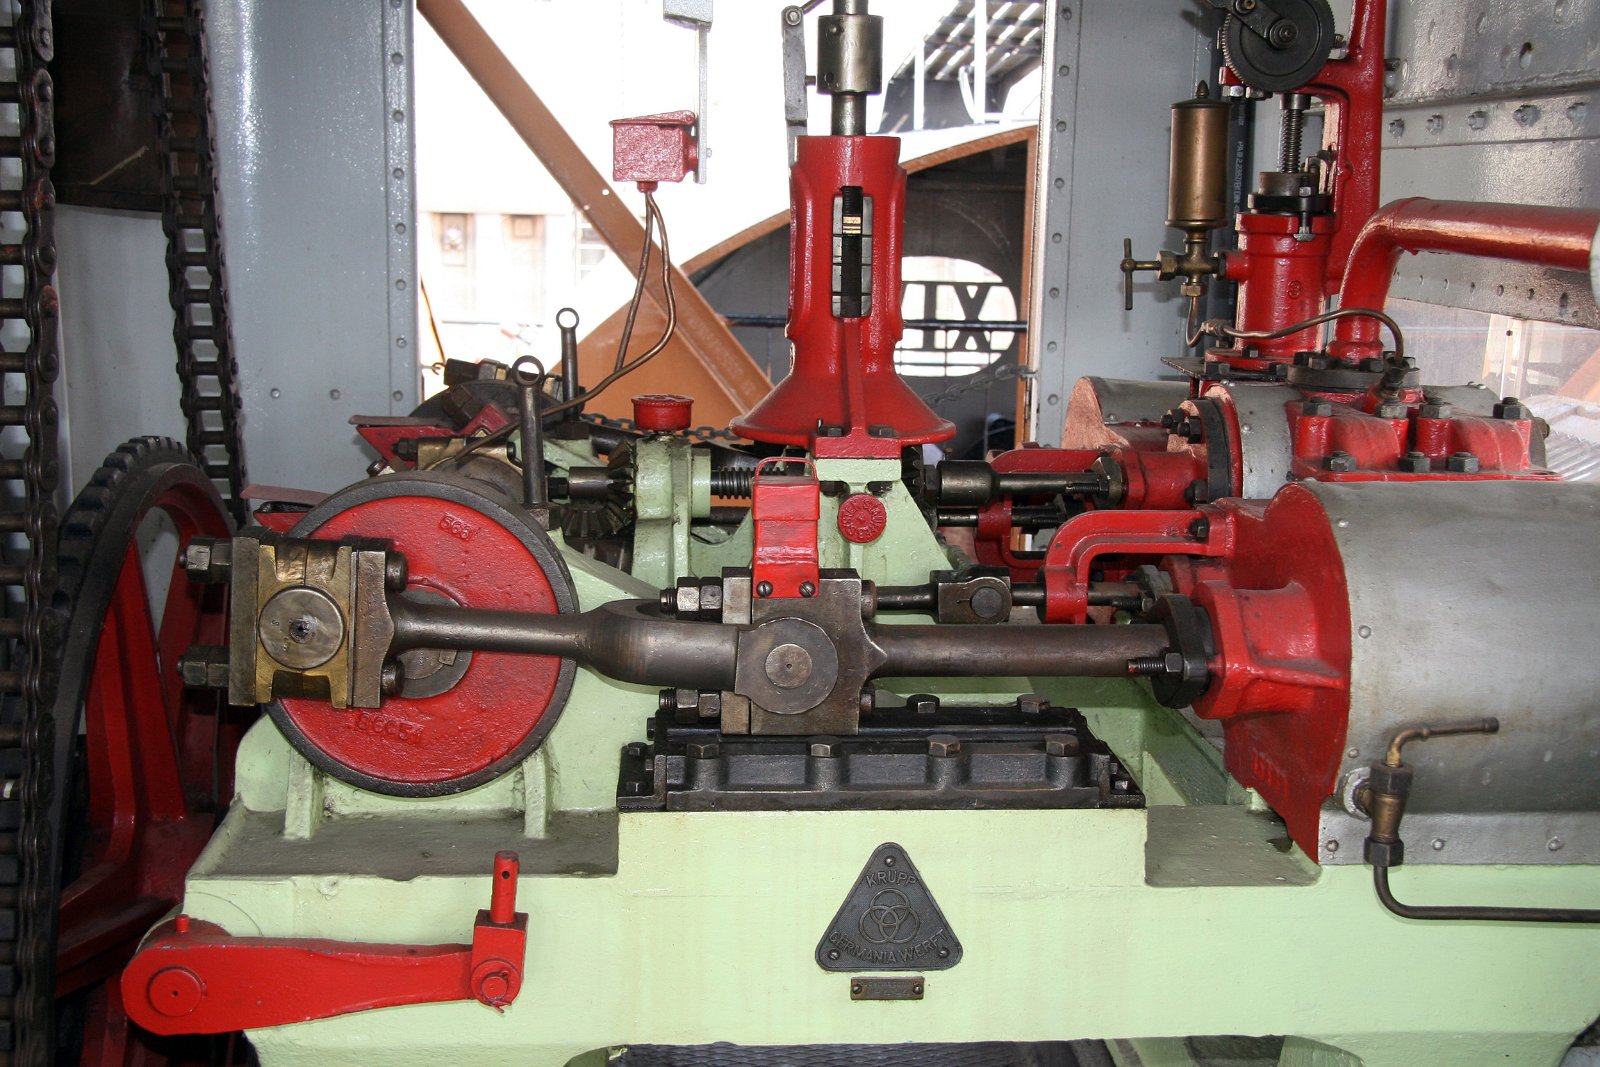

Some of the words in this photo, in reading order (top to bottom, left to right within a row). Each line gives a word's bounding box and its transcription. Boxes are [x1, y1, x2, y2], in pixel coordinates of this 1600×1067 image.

[866, 870, 918, 888] KRUPP
[829, 931, 897, 964] GERMANIA
[899, 927, 948, 962] WERFT
